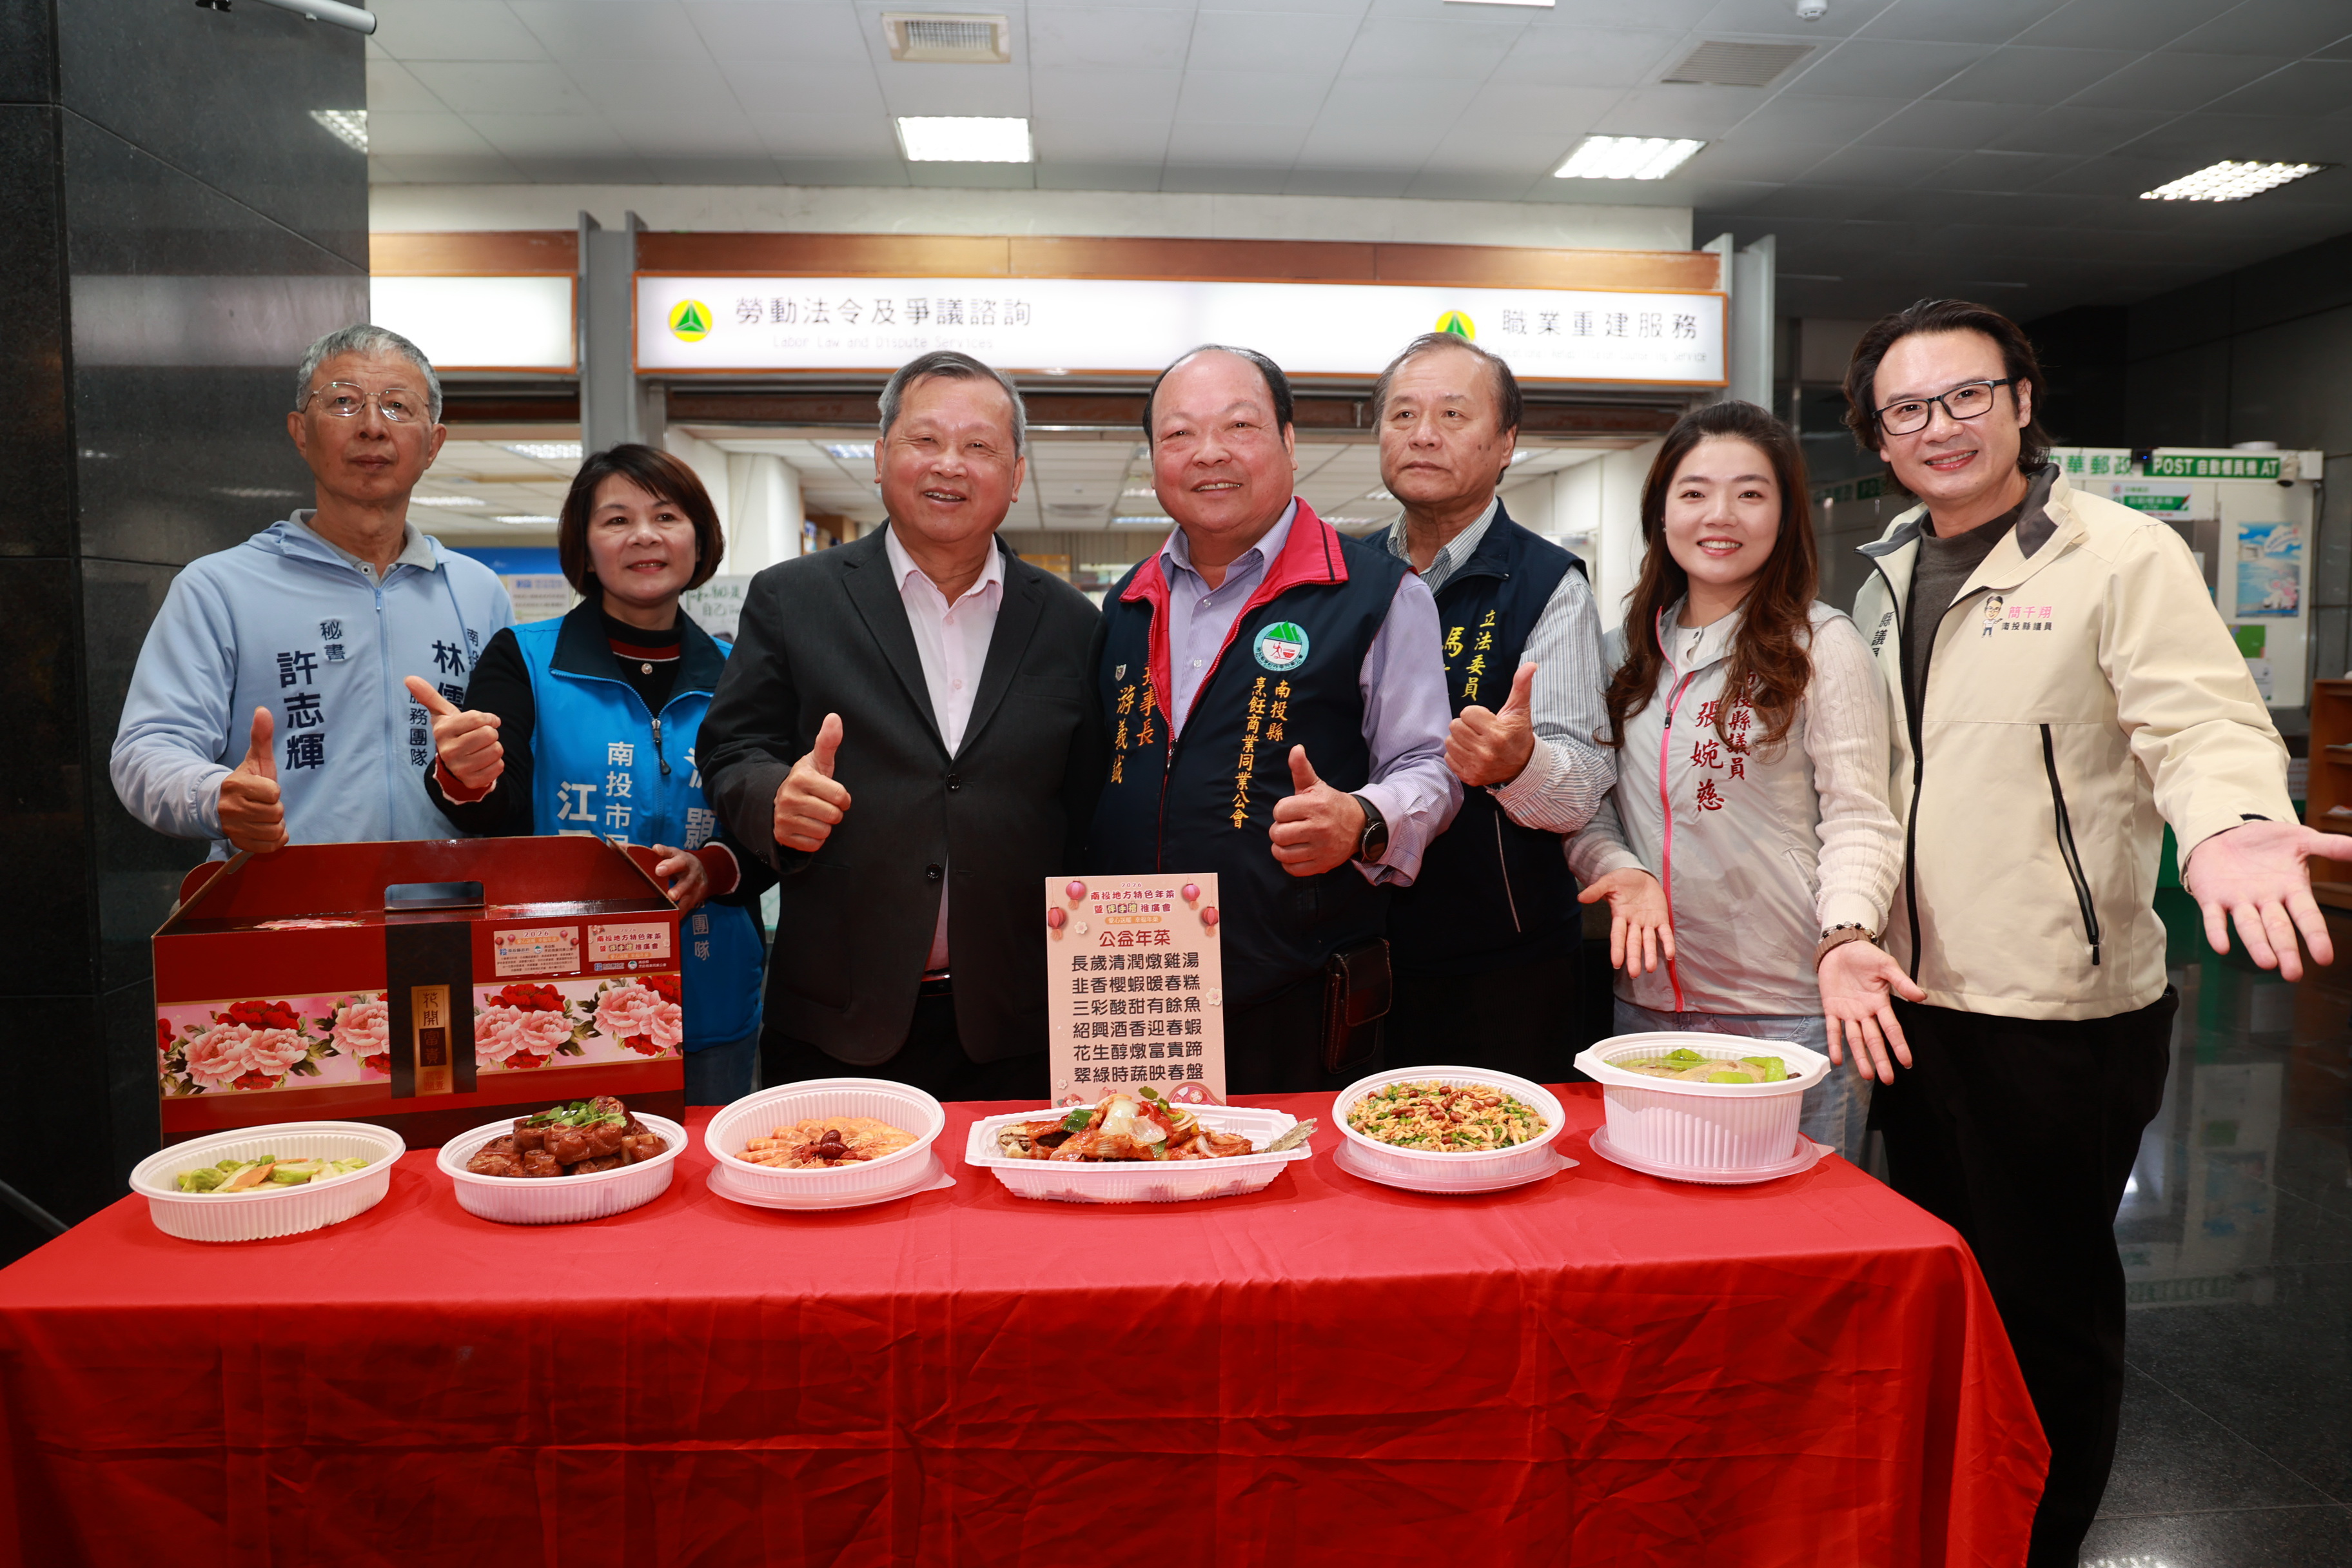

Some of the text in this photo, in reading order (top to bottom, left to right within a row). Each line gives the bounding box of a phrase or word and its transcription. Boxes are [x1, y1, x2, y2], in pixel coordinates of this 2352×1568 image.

[735, 297, 1031, 327] 勞動法令及爭議諮詢
[1502, 309, 1698, 340] 職業重建服務
[773, 335, 994, 351] Labor Law and Dispute Services
[2153, 457, 2194, 475] POST
[2260, 460, 2279, 476] AT
[2008, 605, 2052, 619] 簡千翔
[2001, 622, 2052, 631] 南投縣議員
[320, 620, 346, 661] 秘書
[1461, 609, 1496, 701] 立法委員
[277, 651, 325, 770] 許志輝
[1266, 680, 1291, 741] 南投縣
[1230, 676, 1267, 829] 烹飪商業同業公會
[556, 781, 598, 836] 江
[1090, 890, 1175, 901] 南投地方特色年菜
[597, 932, 662, 942] 南投地方特色年菜
[691, 901, 710, 961] 團隊
[1099, 929, 1171, 948] 公益年菜
[1072, 952, 1199, 972] 長歲清潤燉雞湯
[1072, 974, 1200, 994] 韭香櫻蝦暖春糕
[1072, 996, 1201, 1016] 三彩酸甜有餘魚
[1073, 1018, 1202, 1039] 紹興酒香迎春蝦
[1073, 1041, 1203, 1061] 花生醇燉富貴蹄
[1074, 1063, 1204, 1084] 翠綠時蔬映春盤
